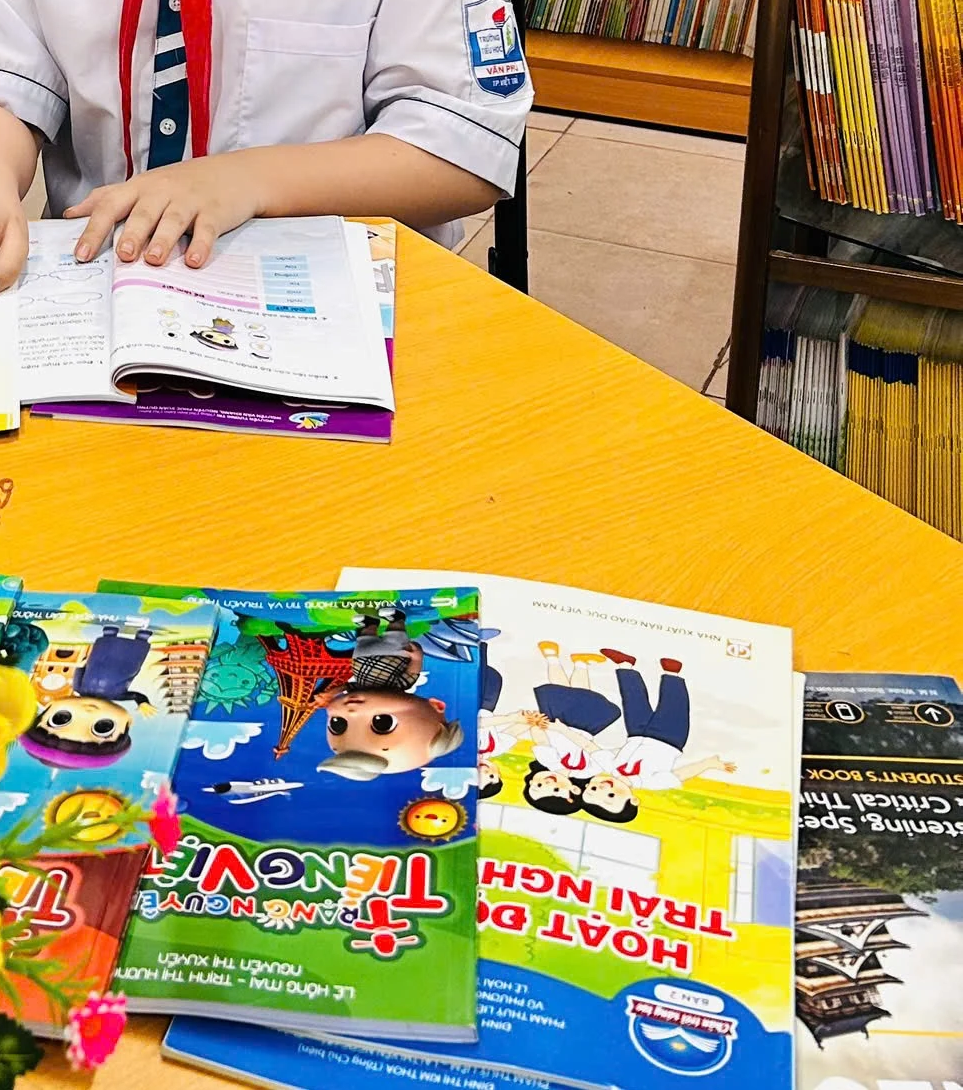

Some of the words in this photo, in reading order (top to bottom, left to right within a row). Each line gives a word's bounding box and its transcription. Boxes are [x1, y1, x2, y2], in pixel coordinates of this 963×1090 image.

[532, 600, 558, 612] NAM
[559, 604, 583, 617] VIỆT
[583, 609, 608, 621] DỤC
[610, 615, 638, 627] GIÁO
[639, 620, 663, 632] BẢN
[664, 626, 694, 638] XUẤT
[697, 632, 723, 643] NHÀ
[806, 768, 864, 782] BOOK
[867, 770, 963, 786] STUDENT'S
[851, 793, 952, 814] Critical
[141, 835, 258, 895] VIỆT
[255, 850, 445, 913] TIẾNG
[480, 860, 592, 904] NGH
[133, 891, 256, 920] NGUYÊ
[611, 887, 732, 938] TRẢI
[257, 897, 419, 957] TRẠNG
[541, 913, 689, 970] HOẠT
[212, 954, 236, 971] THỊ
[240, 960, 303, 978] NGUYỄN
[162, 967, 186, 983] THỊ
[189, 969, 234, 987] TRỊNH
[248, 976, 283, 992] MAI
[286, 980, 329, 1000] HỒNG
[333, 984, 356, 1000] LÊ
[477, 1004, 495, 1016] LIÊ
[526, 998, 545, 1011] VŨ
[635, 1002, 655, 1018] tạo
[655, 1006, 680, 1024] sáng
[680, 1012, 700, 1029] trời
[480, 1019, 512, 1032] ĐINH
[701, 1017, 730, 1034] Chân
